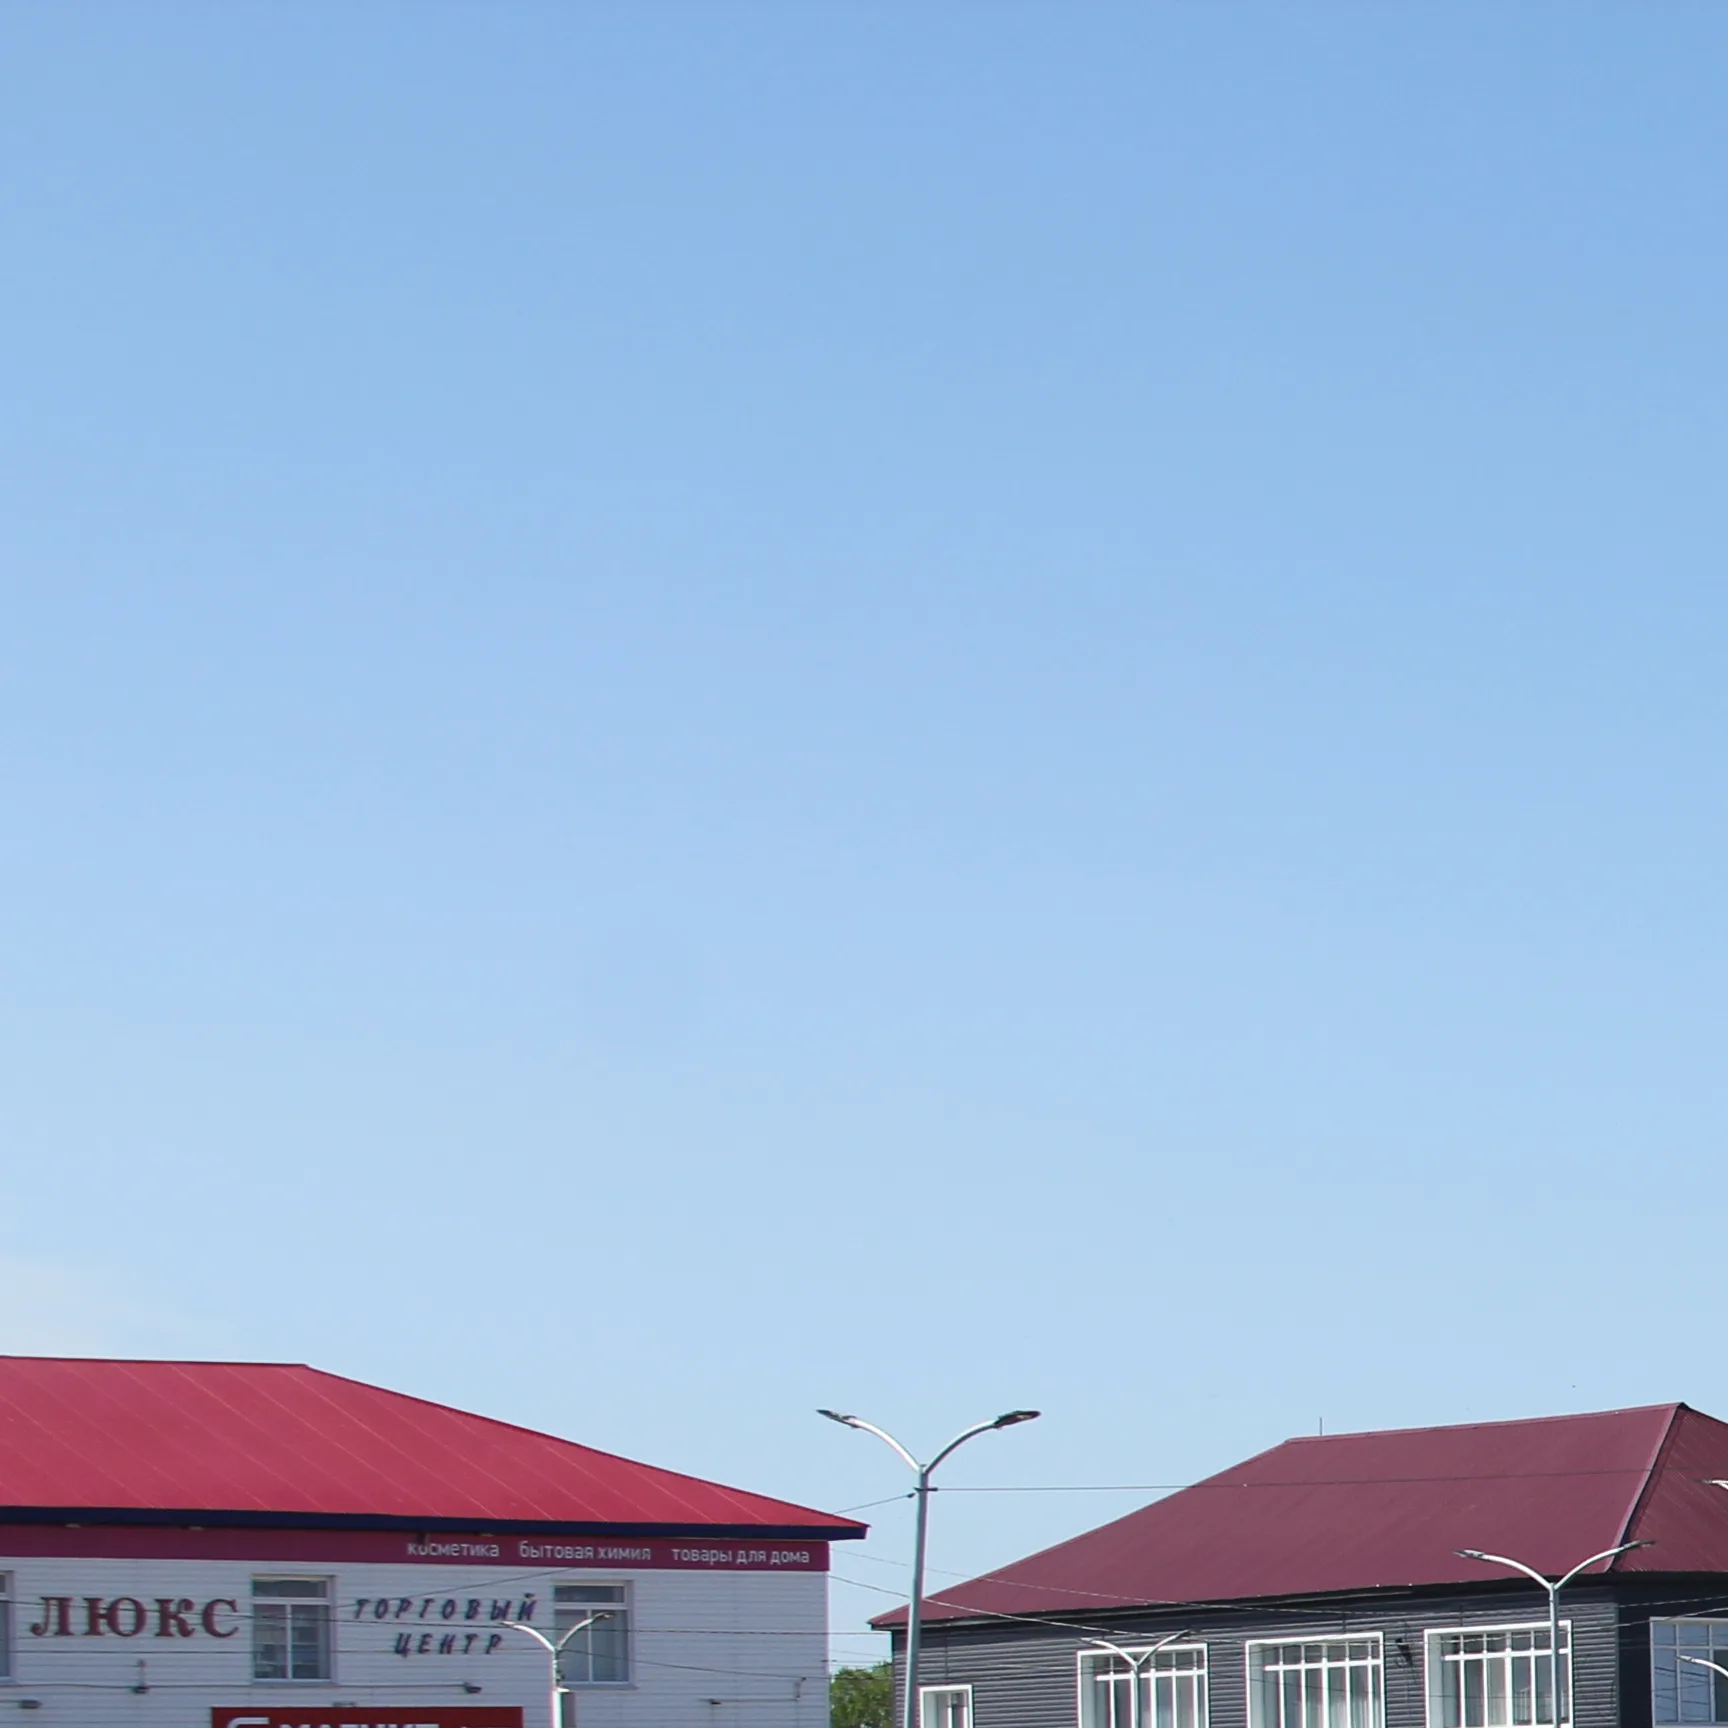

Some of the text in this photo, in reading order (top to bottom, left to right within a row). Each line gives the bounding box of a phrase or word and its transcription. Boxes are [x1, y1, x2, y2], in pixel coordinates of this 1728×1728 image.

[407, 1540, 810, 1566] косметика бытовая химия товары для дома
[30, 1597, 239, 1638] ЛЮКС
[355, 1592, 537, 1621] ТОРГОВЫЙ
[394, 1633, 502, 1658] ЦЕНТР
